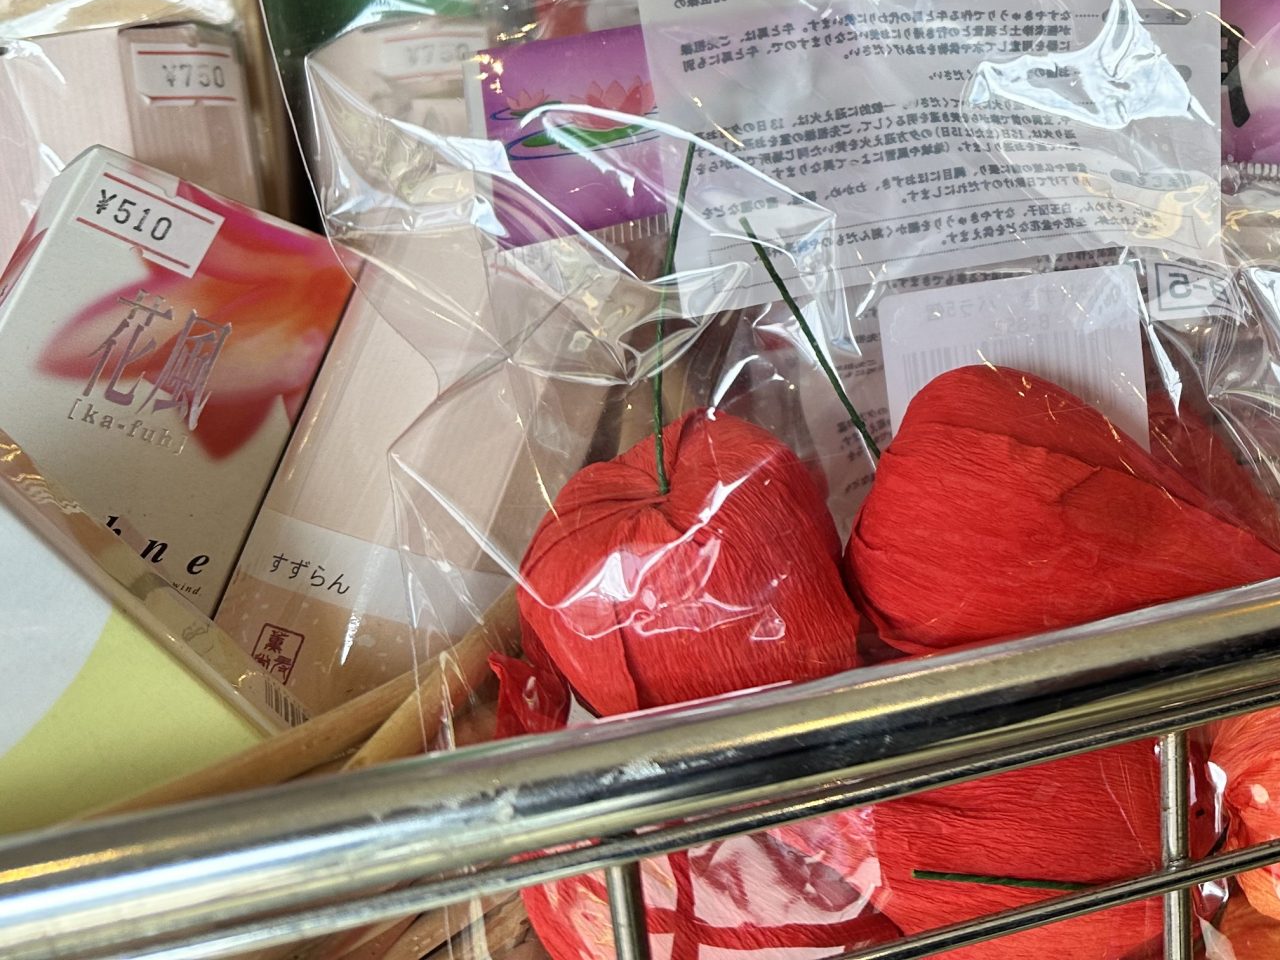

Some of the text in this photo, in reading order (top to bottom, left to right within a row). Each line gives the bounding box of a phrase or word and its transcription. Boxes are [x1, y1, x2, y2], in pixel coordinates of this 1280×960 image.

[162, 63, 225, 88] ¥750
[95, 188, 173, 241] ¥510
[269, 552, 351, 595] すずらん
